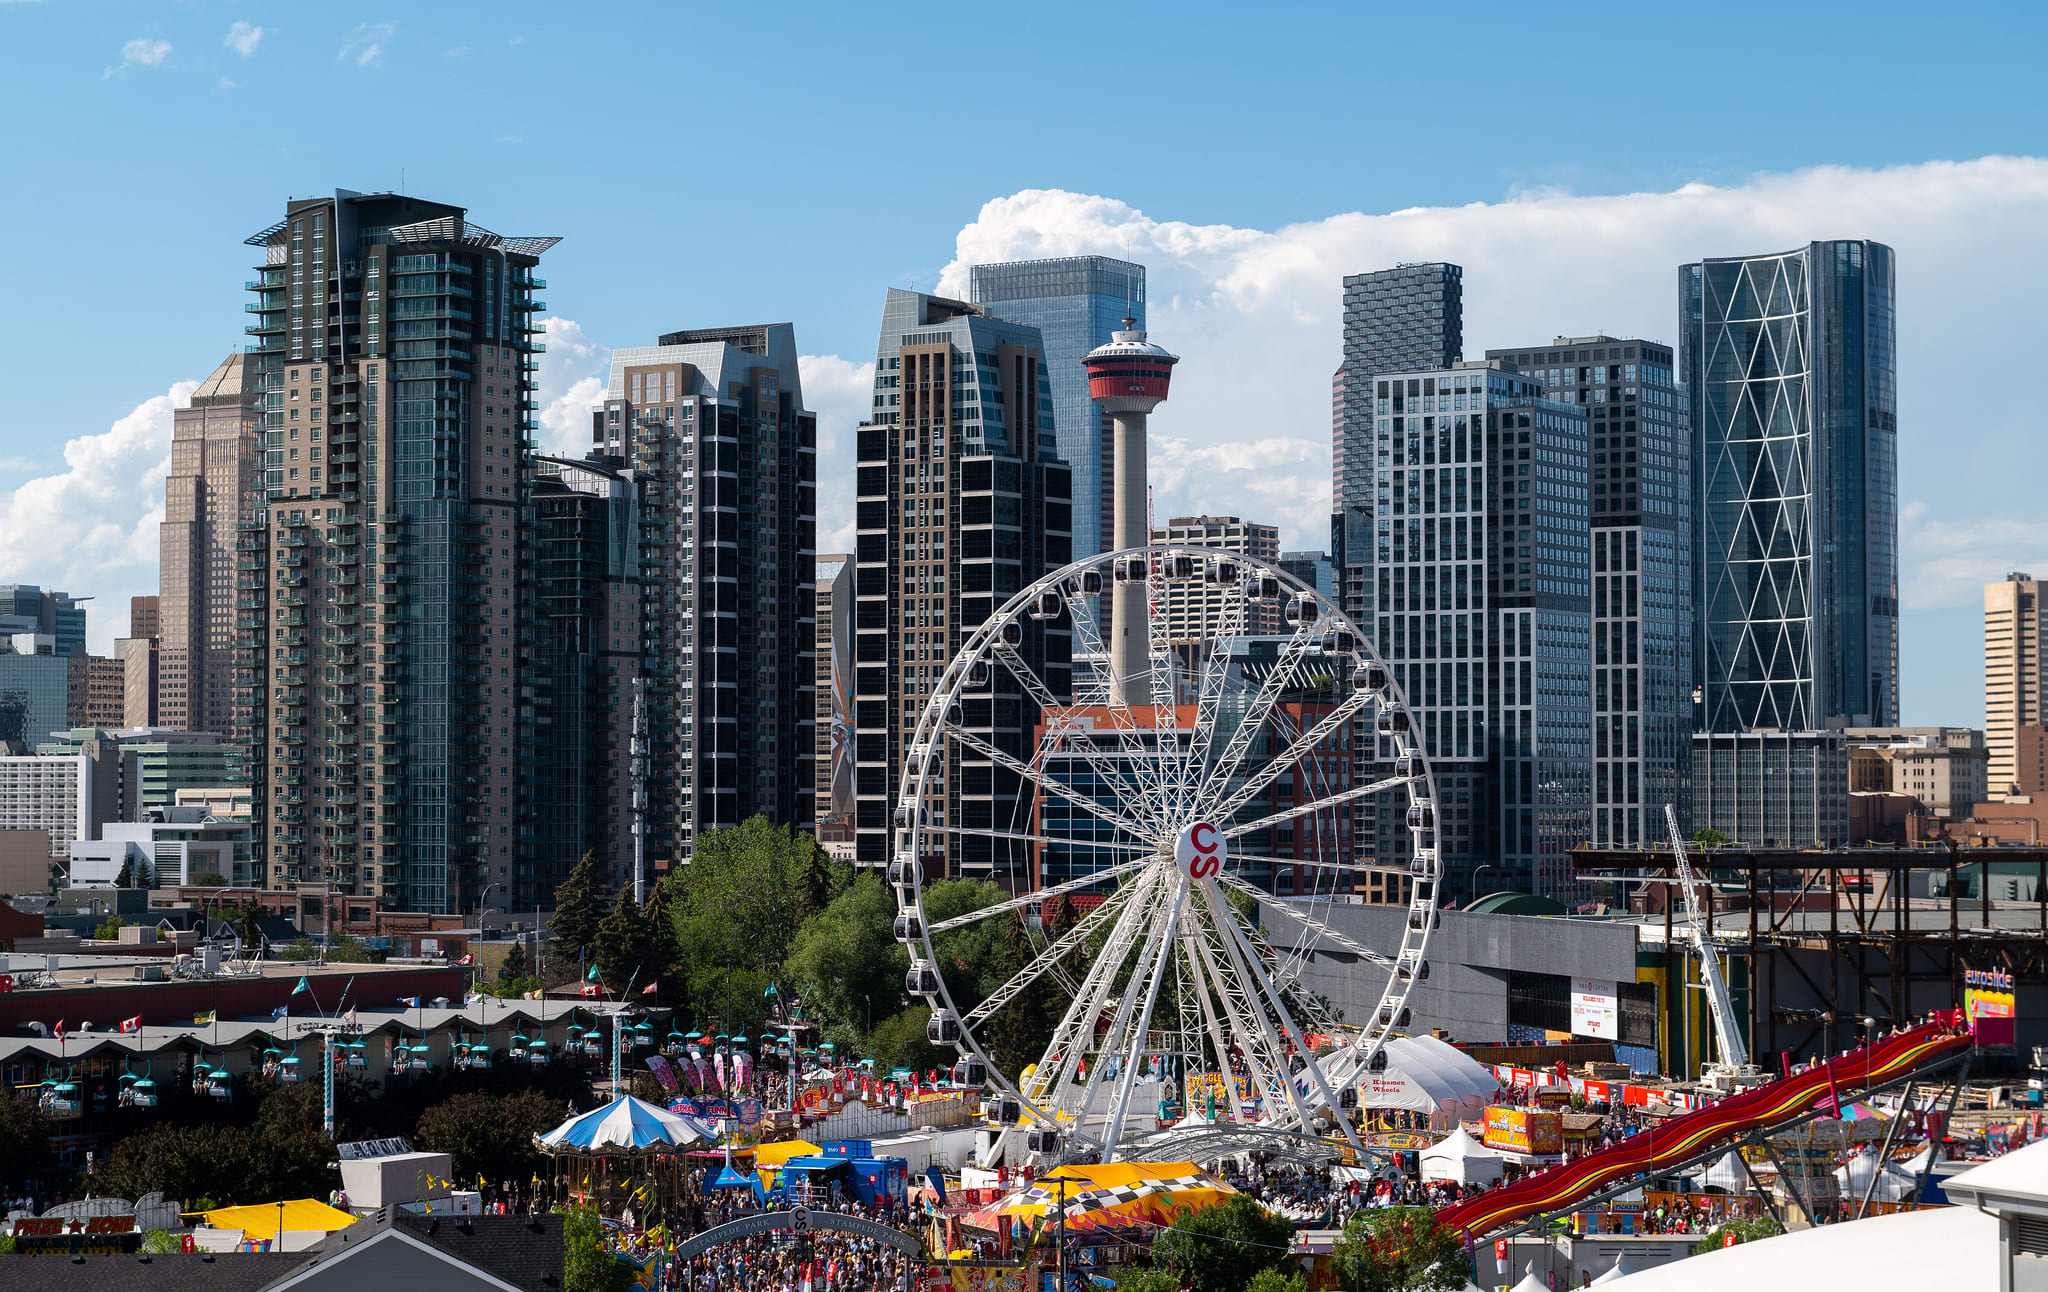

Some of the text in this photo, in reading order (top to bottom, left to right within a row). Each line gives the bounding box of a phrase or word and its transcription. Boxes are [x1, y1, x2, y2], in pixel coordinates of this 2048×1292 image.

[1965, 966, 2013, 989] euroslide
[706, 1105, 736, 1116] FUNNL
[13, 1215, 136, 1235] PRIZE ZONE
[693, 1218, 770, 1250] STAMPEDE PARK
[830, 1217, 906, 1246] STAMPEDE PARK
